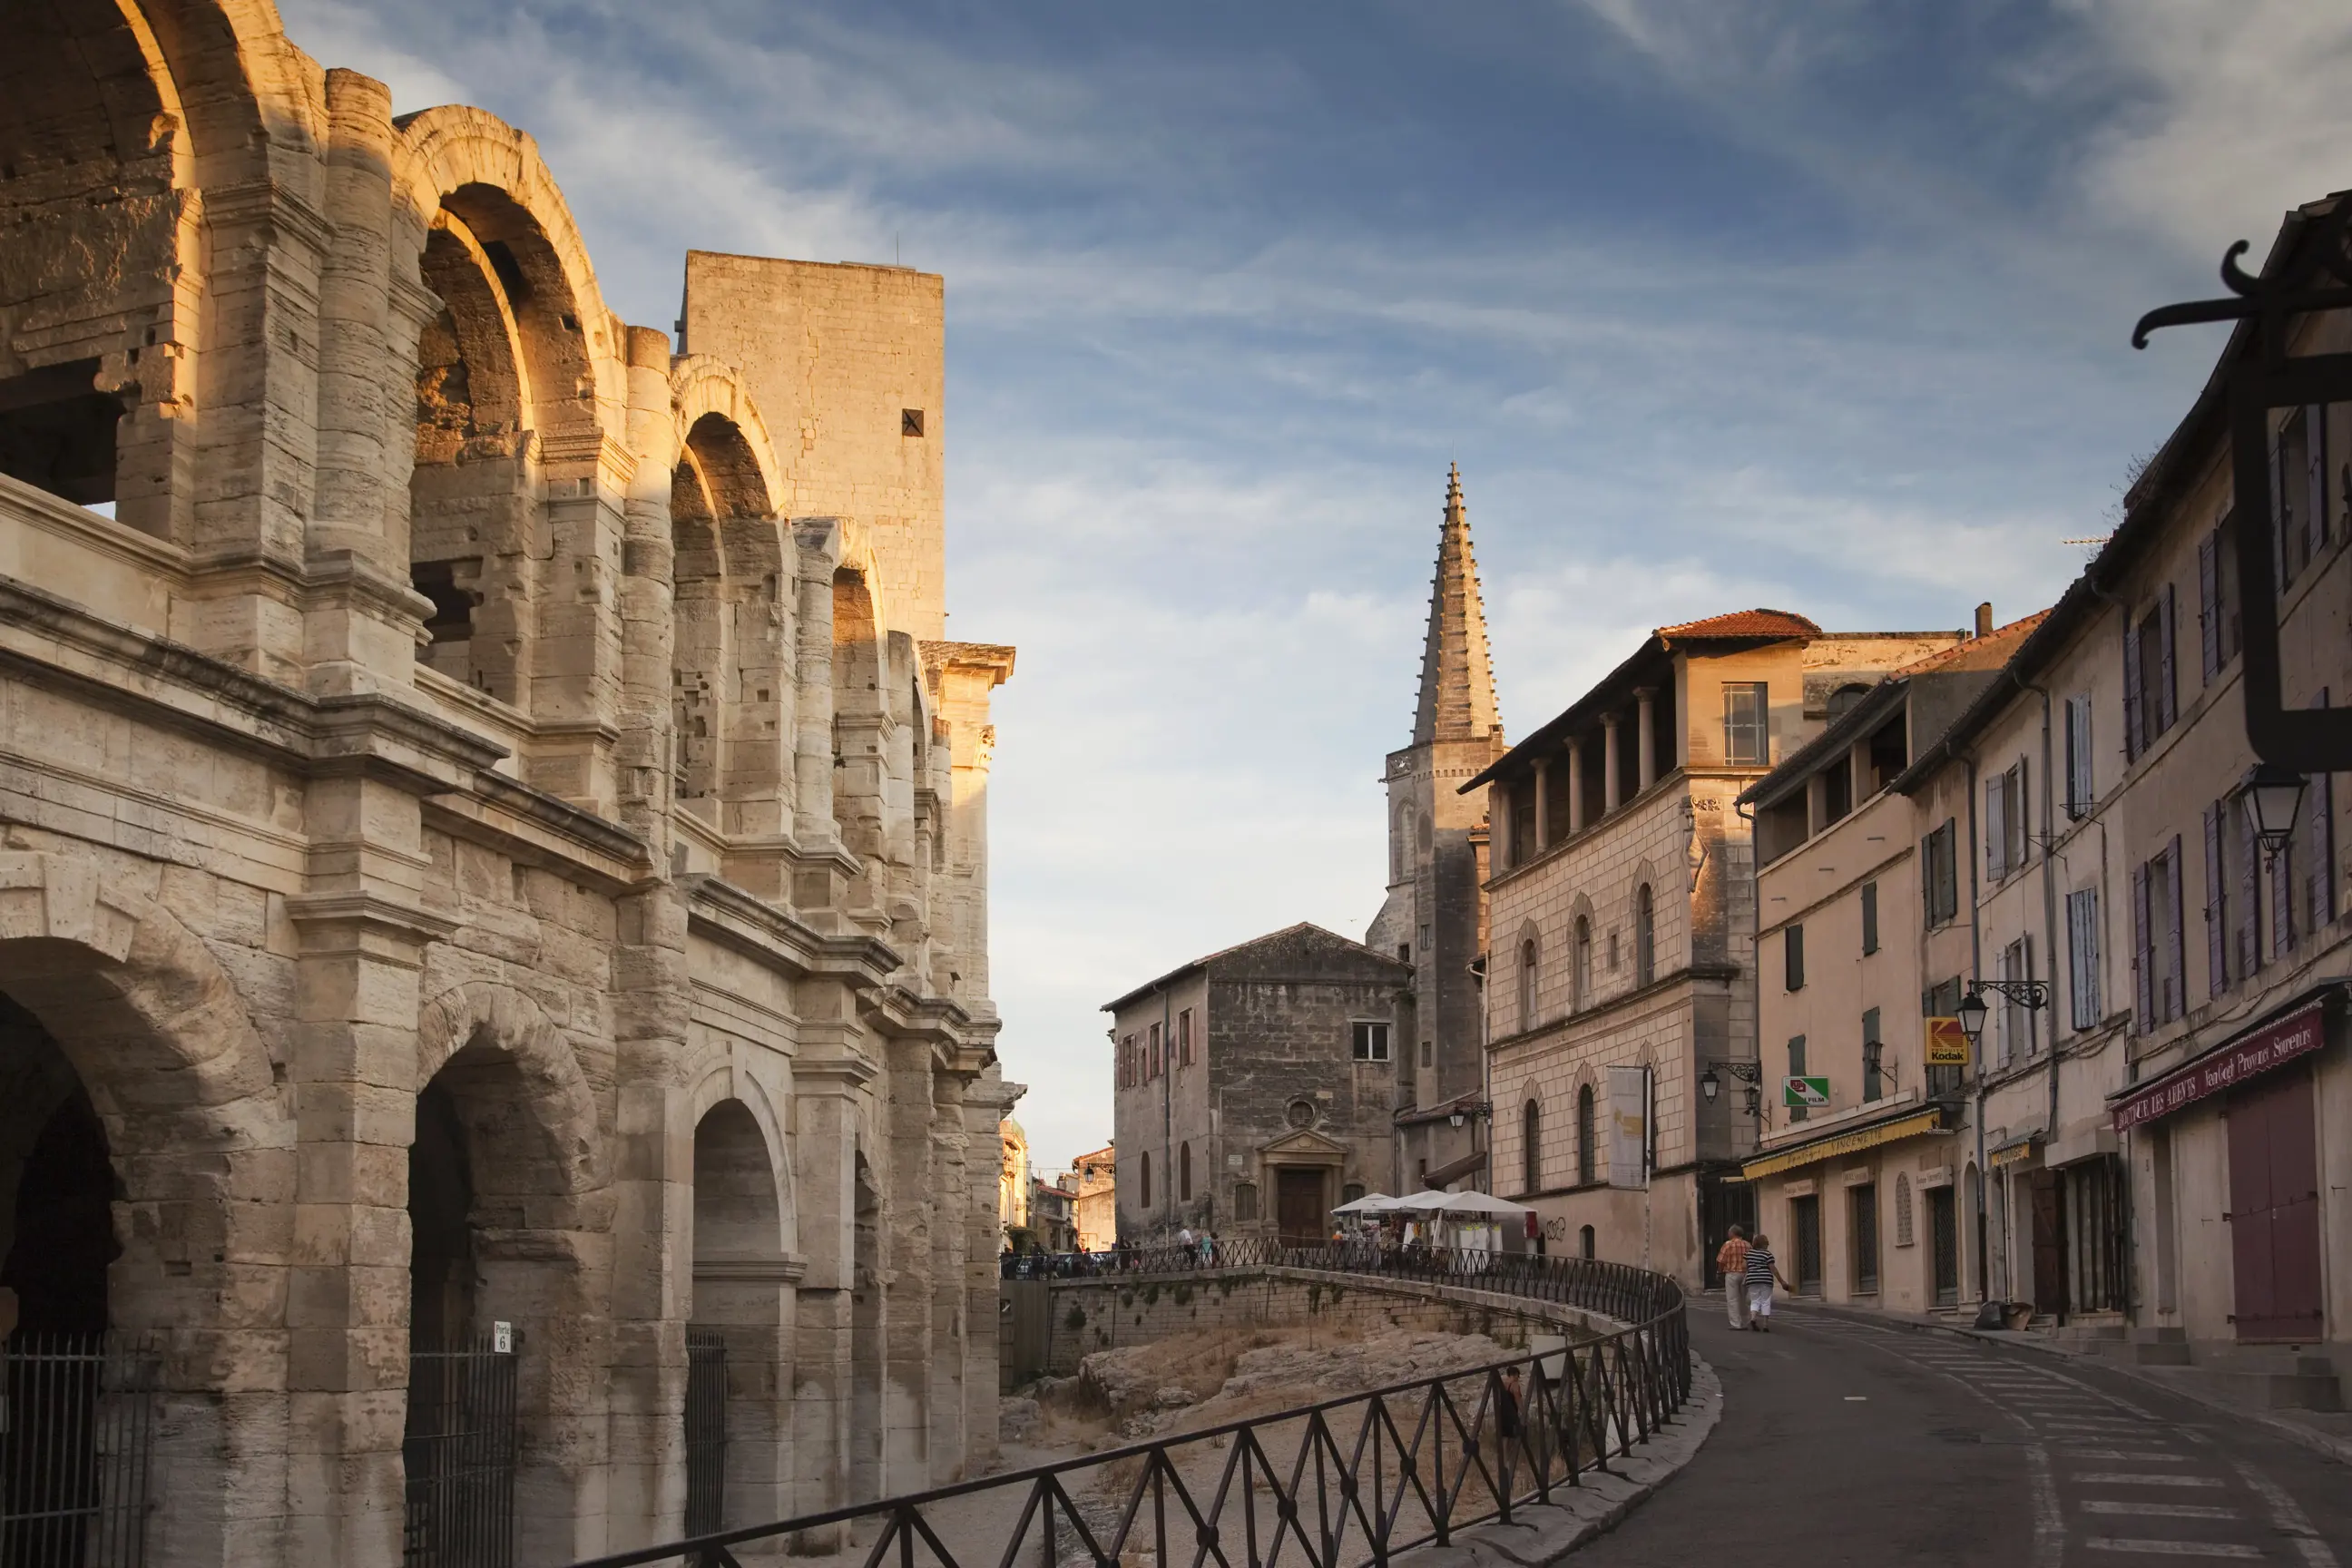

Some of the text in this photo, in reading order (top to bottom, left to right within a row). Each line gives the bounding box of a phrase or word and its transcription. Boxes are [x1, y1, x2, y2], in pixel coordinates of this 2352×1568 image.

[1932, 1052, 1964, 1060] Kodak
[2151, 1092, 2164, 1113] LES
[496, 1325, 509, 1334] Porte
[500, 1336, 505, 1349] 6
